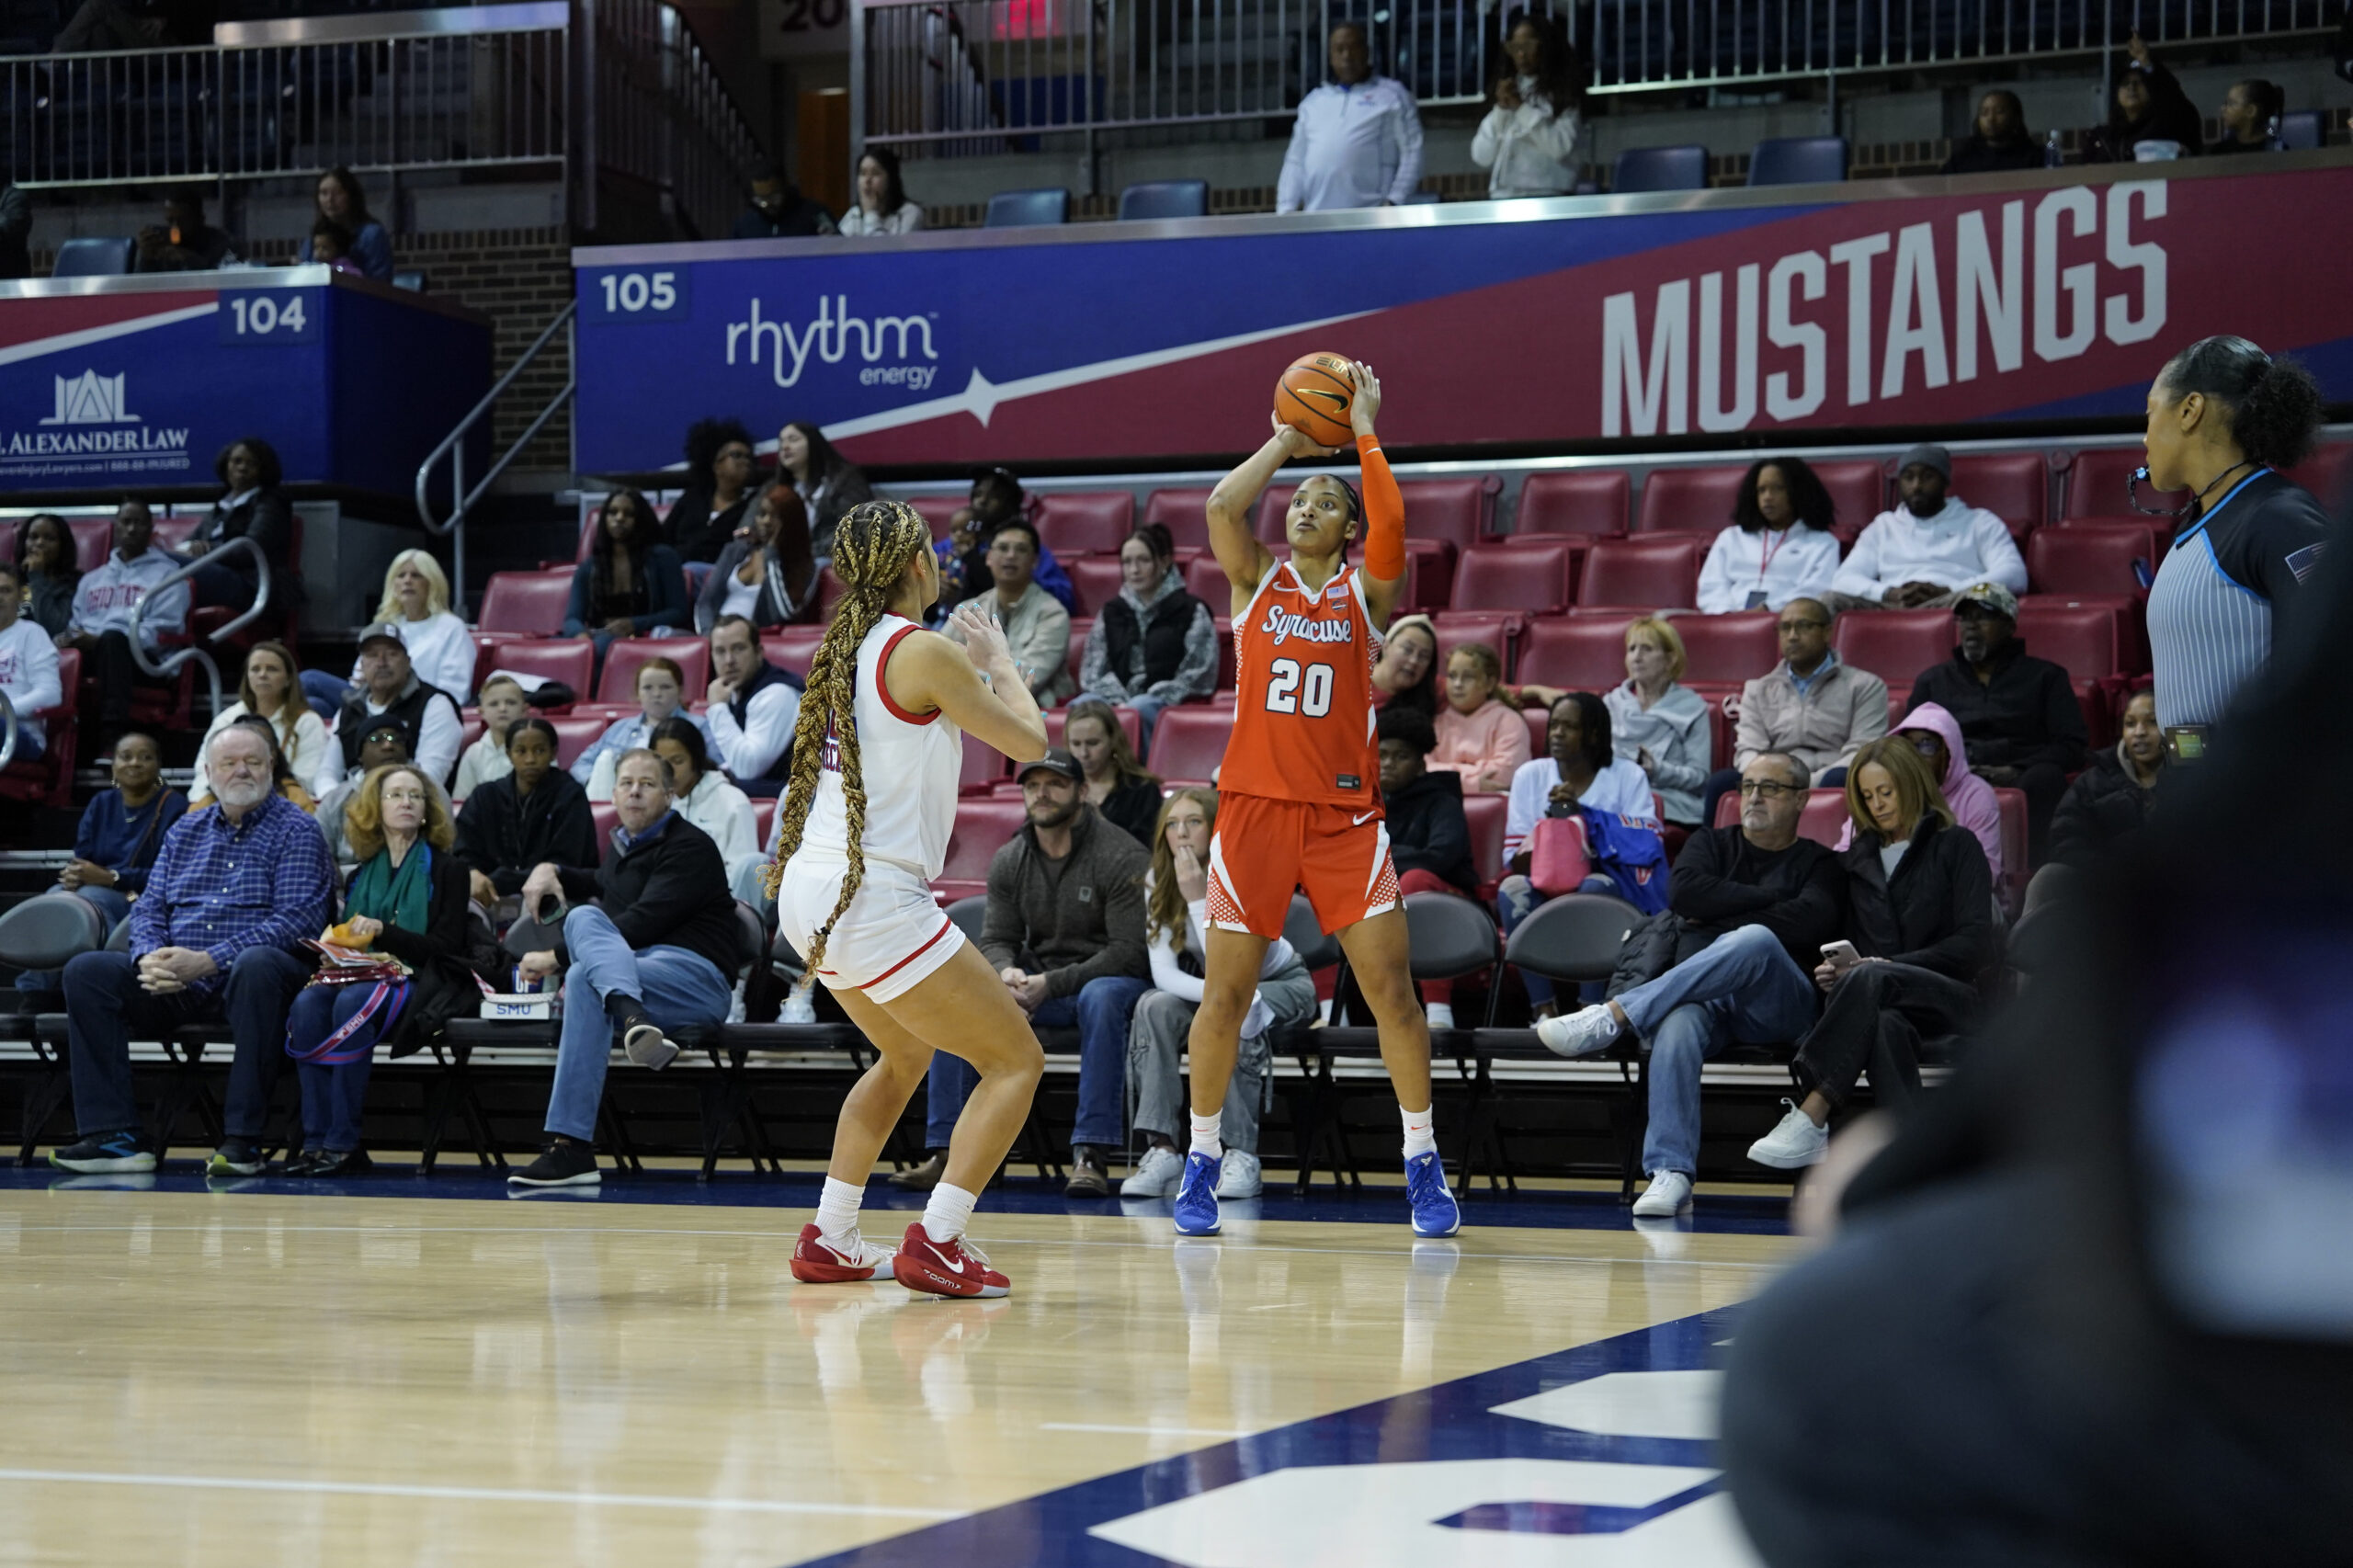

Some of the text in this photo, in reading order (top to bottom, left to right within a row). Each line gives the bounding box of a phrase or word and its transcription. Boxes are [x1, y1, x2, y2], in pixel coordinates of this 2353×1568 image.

[599, 271, 676, 312] 105
[1601, 179, 2167, 437] MUSTANGS
[231, 295, 307, 335] 104
[726, 294, 938, 388] rhythm
[859, 364, 938, 390] energy
[8, 429, 139, 455] ALEXANDER
[142, 426, 189, 449] LAW
[1260, 604, 1352, 646] Syracuse
[1265, 656, 1335, 719] 20
[496, 1004, 531, 1016] SMU
